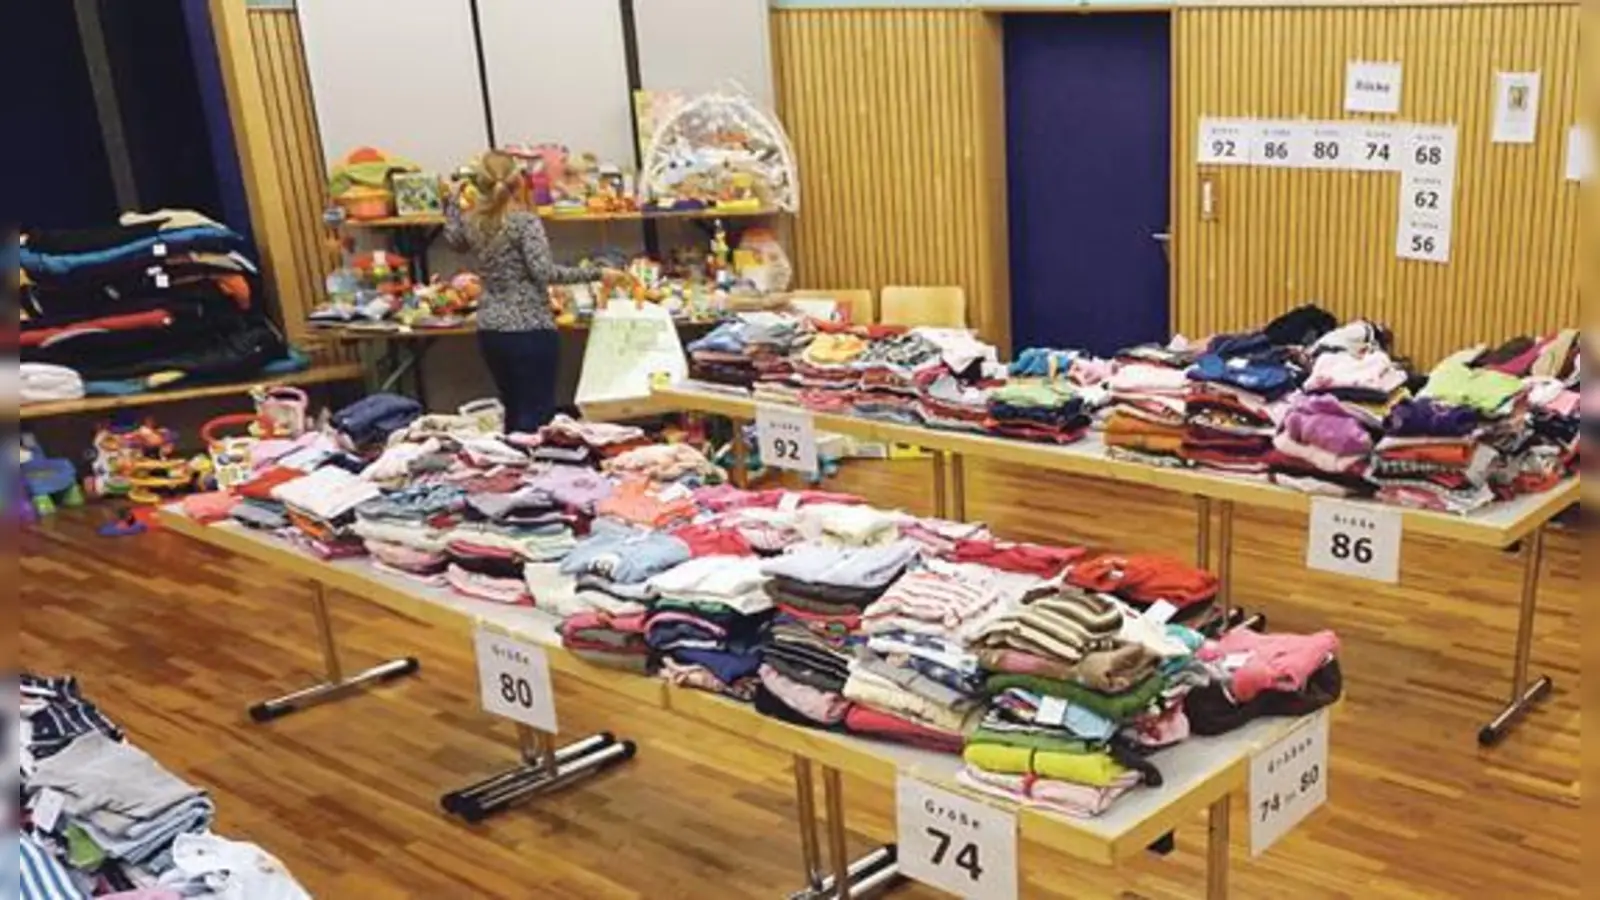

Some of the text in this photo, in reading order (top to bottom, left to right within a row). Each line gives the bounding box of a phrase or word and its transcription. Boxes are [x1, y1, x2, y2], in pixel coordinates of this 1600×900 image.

[1211, 140, 1236, 157] 92
[1264, 142, 1288, 159] 86
[1313, 141, 1339, 159] 80
[1365, 142, 1390, 161] 74
[1415, 145, 1442, 165] 68
[1414, 191, 1439, 209] 62
[1411, 234, 1435, 254] 56
[774, 437, 801, 461] 92
[1330, 532, 1373, 564] 86
[500, 672, 533, 709] 80
[1259, 793, 1280, 822] 74
[1300, 763, 1320, 793] 80
[925, 825, 984, 882] 74
